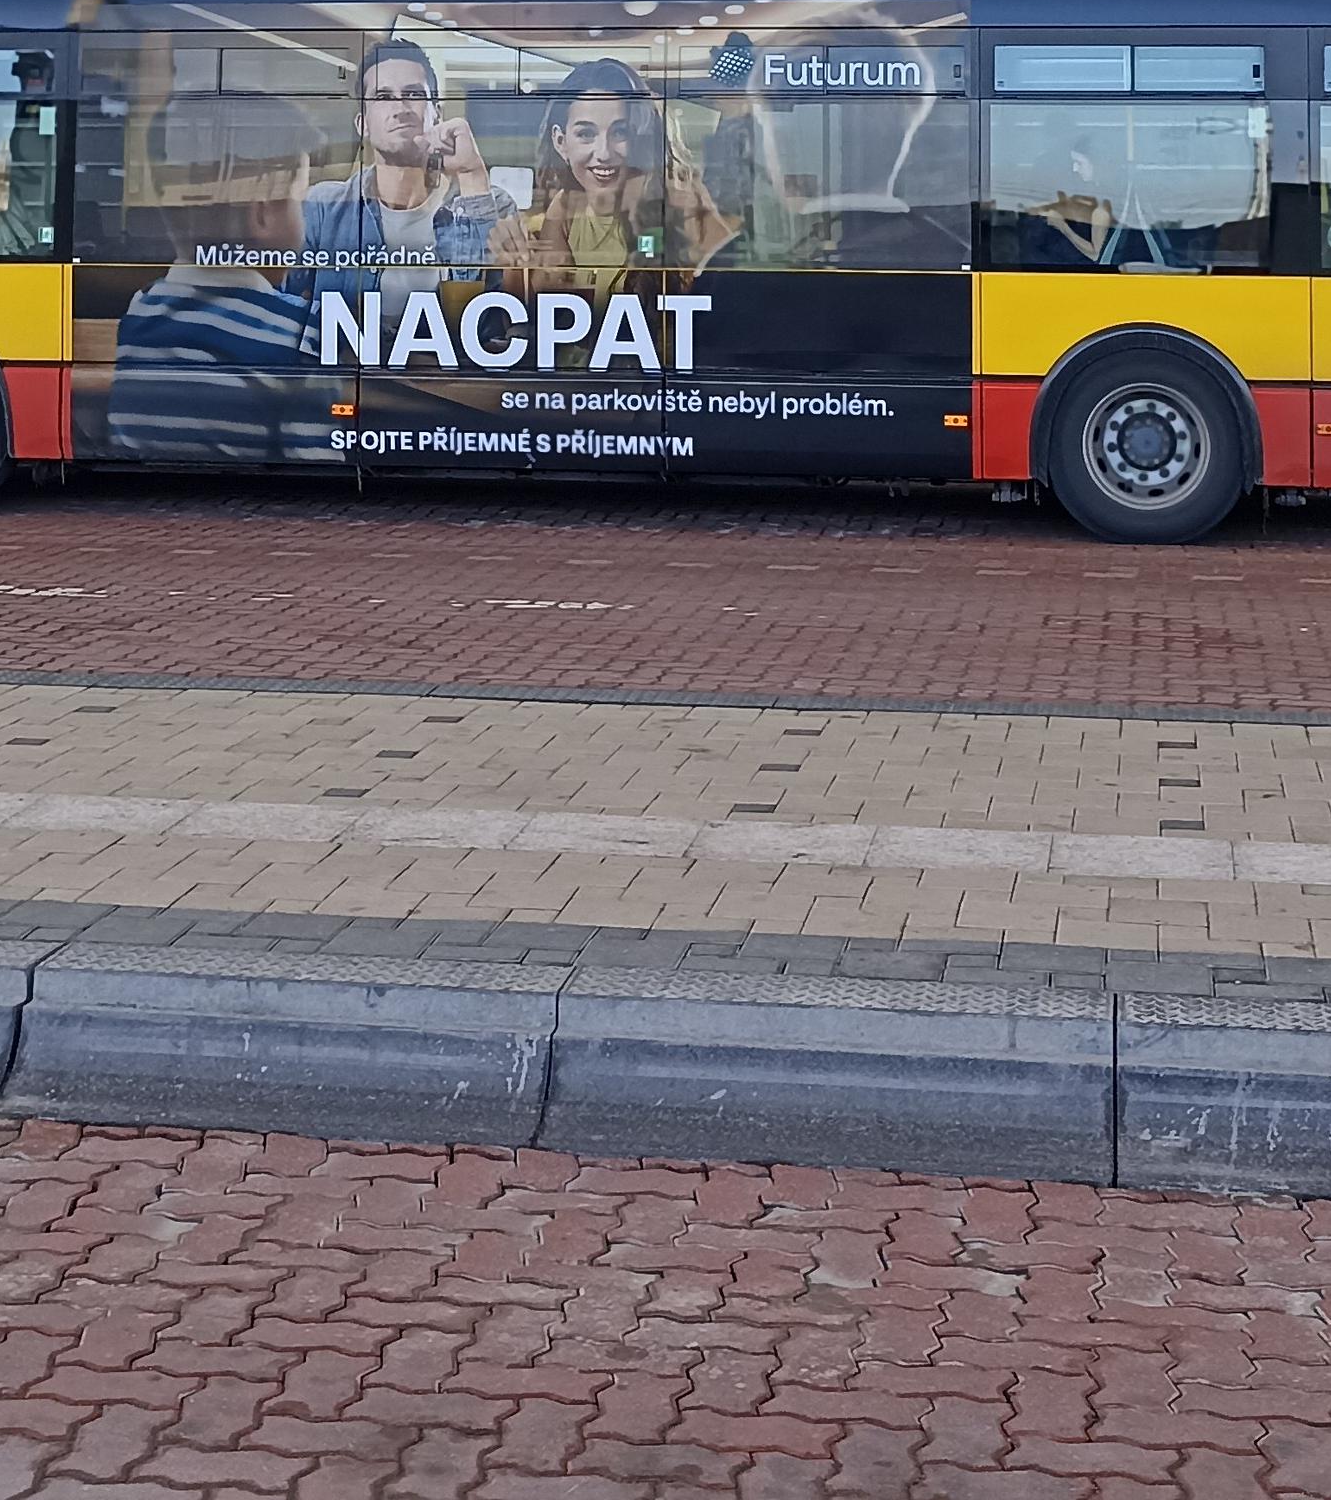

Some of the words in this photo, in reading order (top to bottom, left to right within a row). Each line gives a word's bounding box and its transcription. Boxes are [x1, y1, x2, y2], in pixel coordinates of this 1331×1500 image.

[764, 54, 921, 86] Futurum
[195, 243, 297, 267] Můžeme
[302, 250, 330, 267] se
[335, 245, 436, 272] pořádně
[320, 291, 712, 374] NACPAT
[500, 391, 529, 409] se
[534, 392, 566, 410] na
[571, 388, 702, 416] parkoviště
[708, 390, 776, 419] nebyl
[782, 392, 895, 420] problém.
[330, 429, 413, 454] SPOJTE
[418, 427, 531, 456] PŘÍJEMNÉ
[535, 433, 556, 454] S
